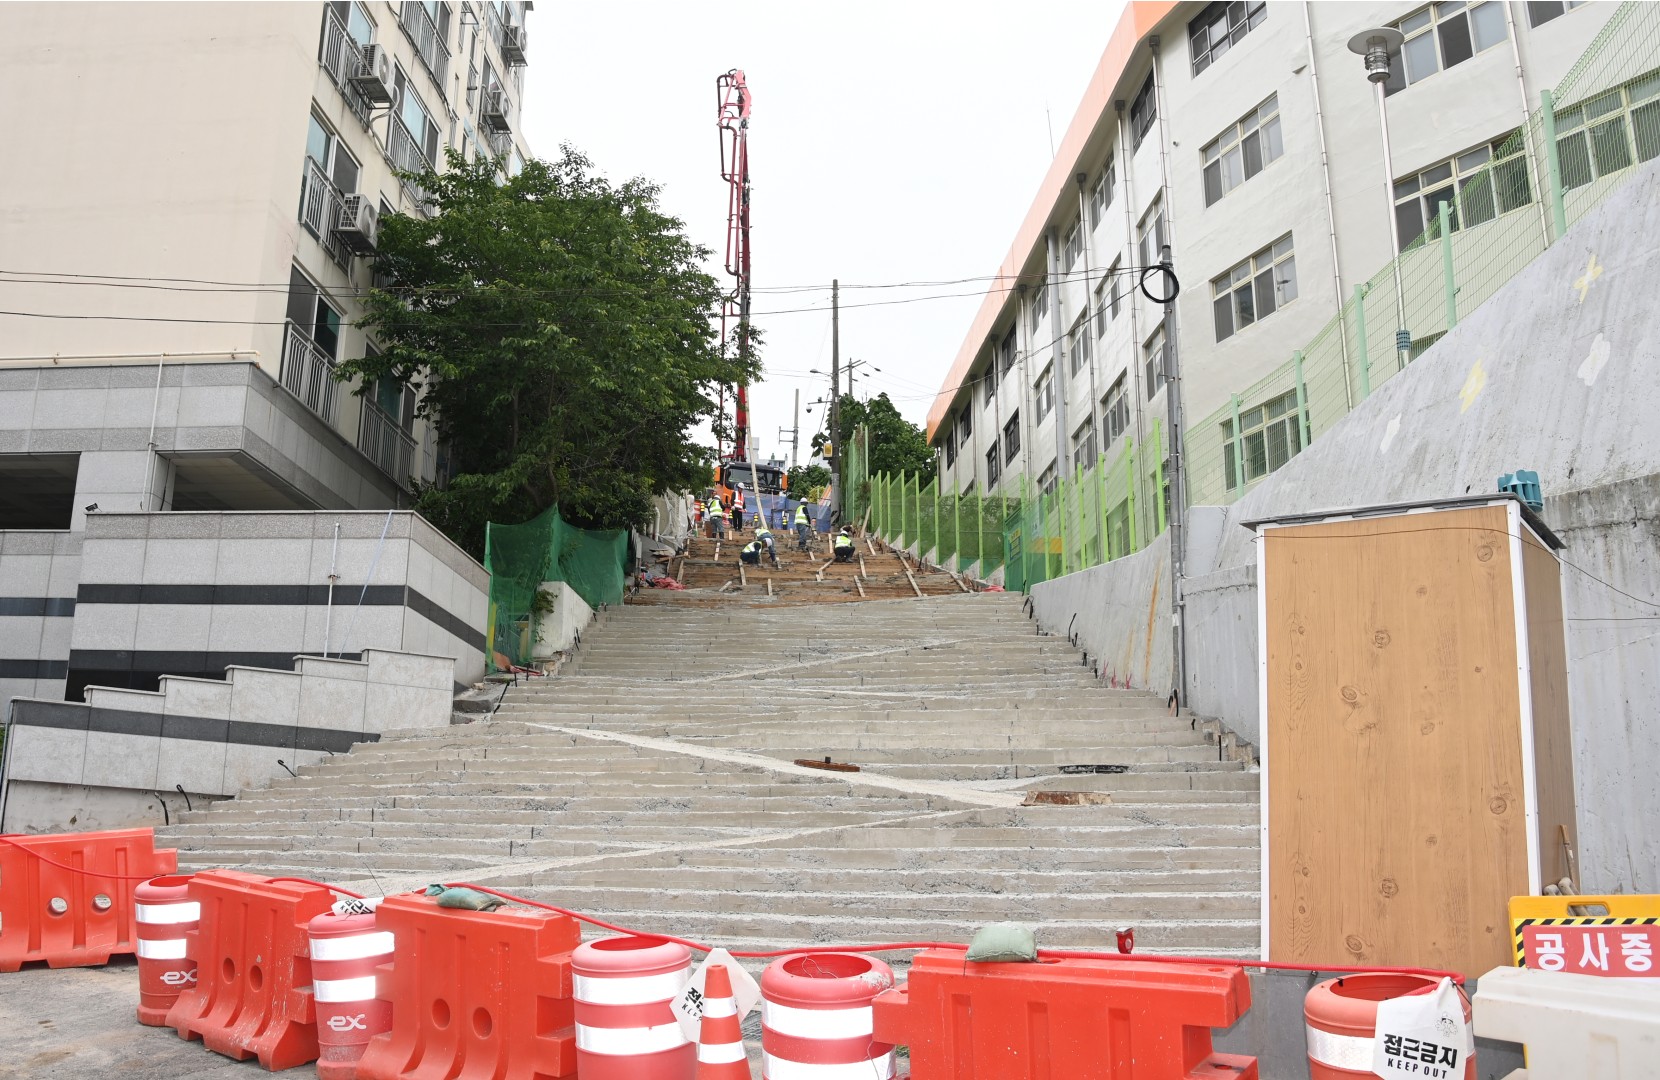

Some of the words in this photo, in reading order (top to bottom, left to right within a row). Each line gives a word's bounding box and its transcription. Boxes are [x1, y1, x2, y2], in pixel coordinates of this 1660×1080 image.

[1535, 932, 1653, 972] 공사중
[327, 1013, 367, 1031] ex
[1383, 1033, 1458, 1069] 접근금지
[1387, 1058, 1419, 1073] KEEP
[1423, 1065, 1447, 1079] OUT
